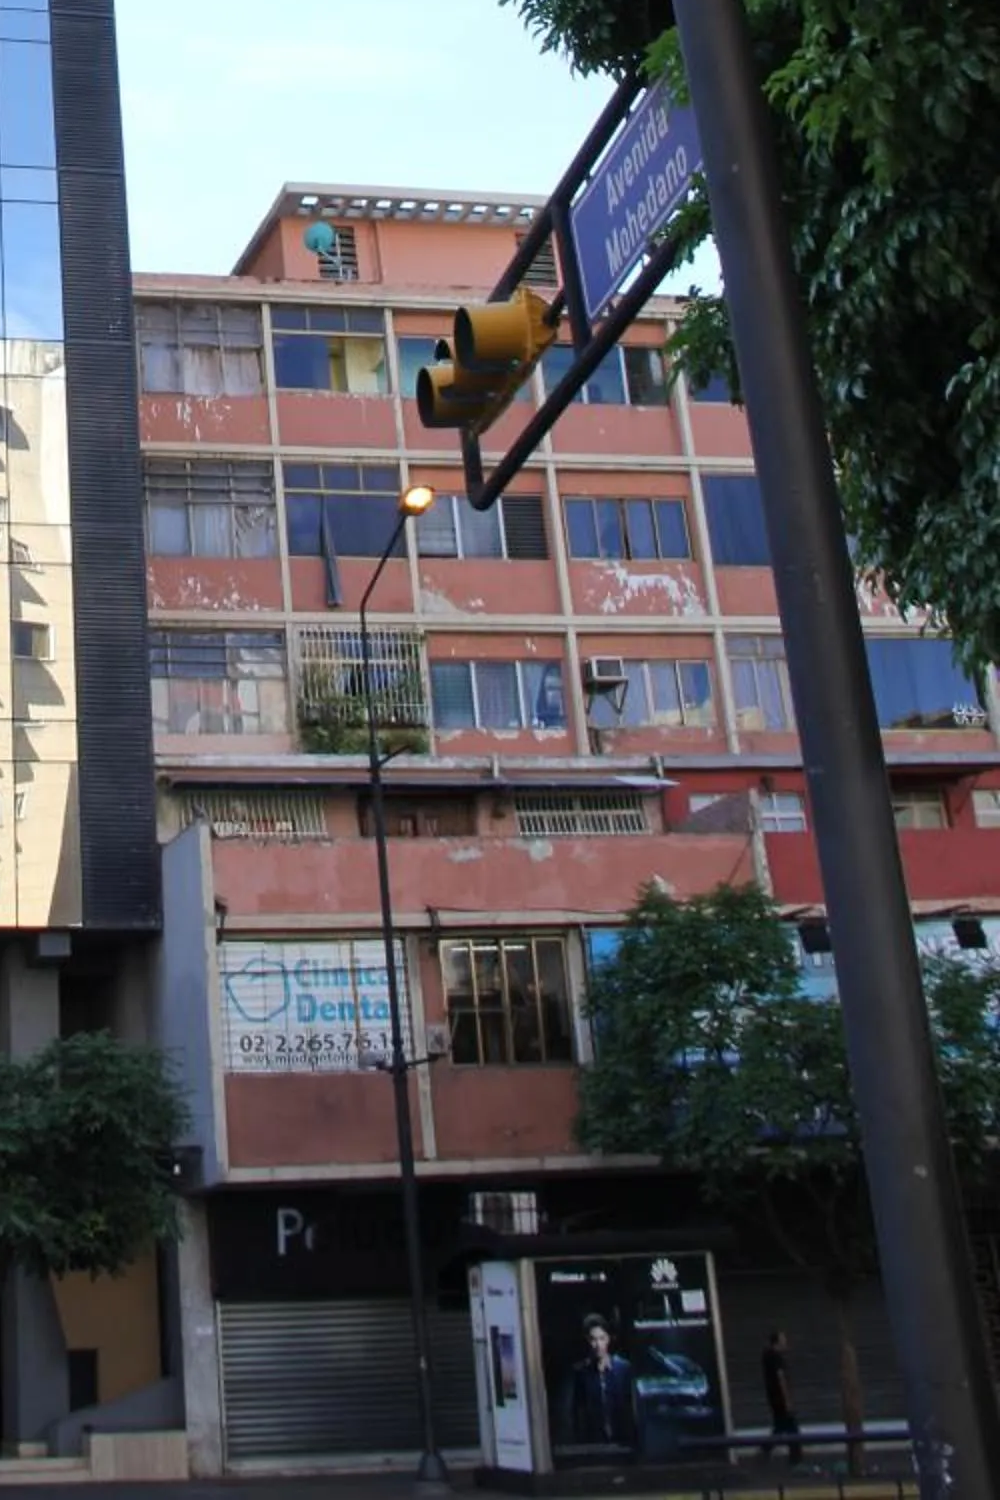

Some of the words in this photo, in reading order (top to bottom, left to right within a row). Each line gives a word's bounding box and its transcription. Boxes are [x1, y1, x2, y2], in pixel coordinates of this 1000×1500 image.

[605, 106, 669, 215] Avenida
[605, 145, 687, 277] Mohedano
[296, 993, 390, 1023] Denta
